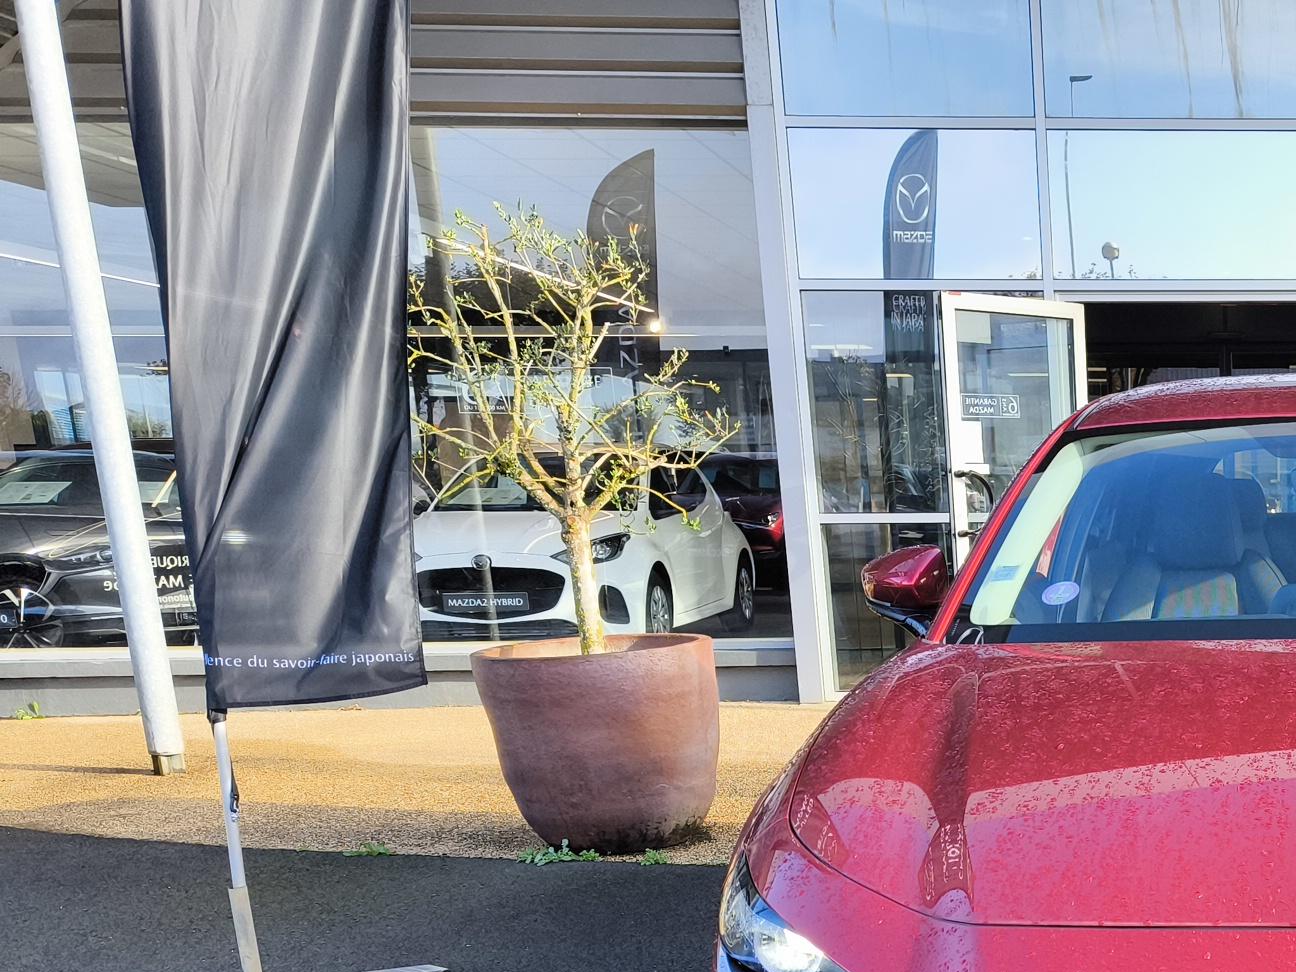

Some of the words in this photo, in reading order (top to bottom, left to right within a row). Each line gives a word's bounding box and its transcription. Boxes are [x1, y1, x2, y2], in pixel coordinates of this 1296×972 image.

[448, 598, 488, 607] MAZDA2
[490, 597, 523, 606] HYBRID
[247, 655, 268, 668] du
[273, 653, 348, 669] savoir-faire
[351, 651, 414, 667] japonais
